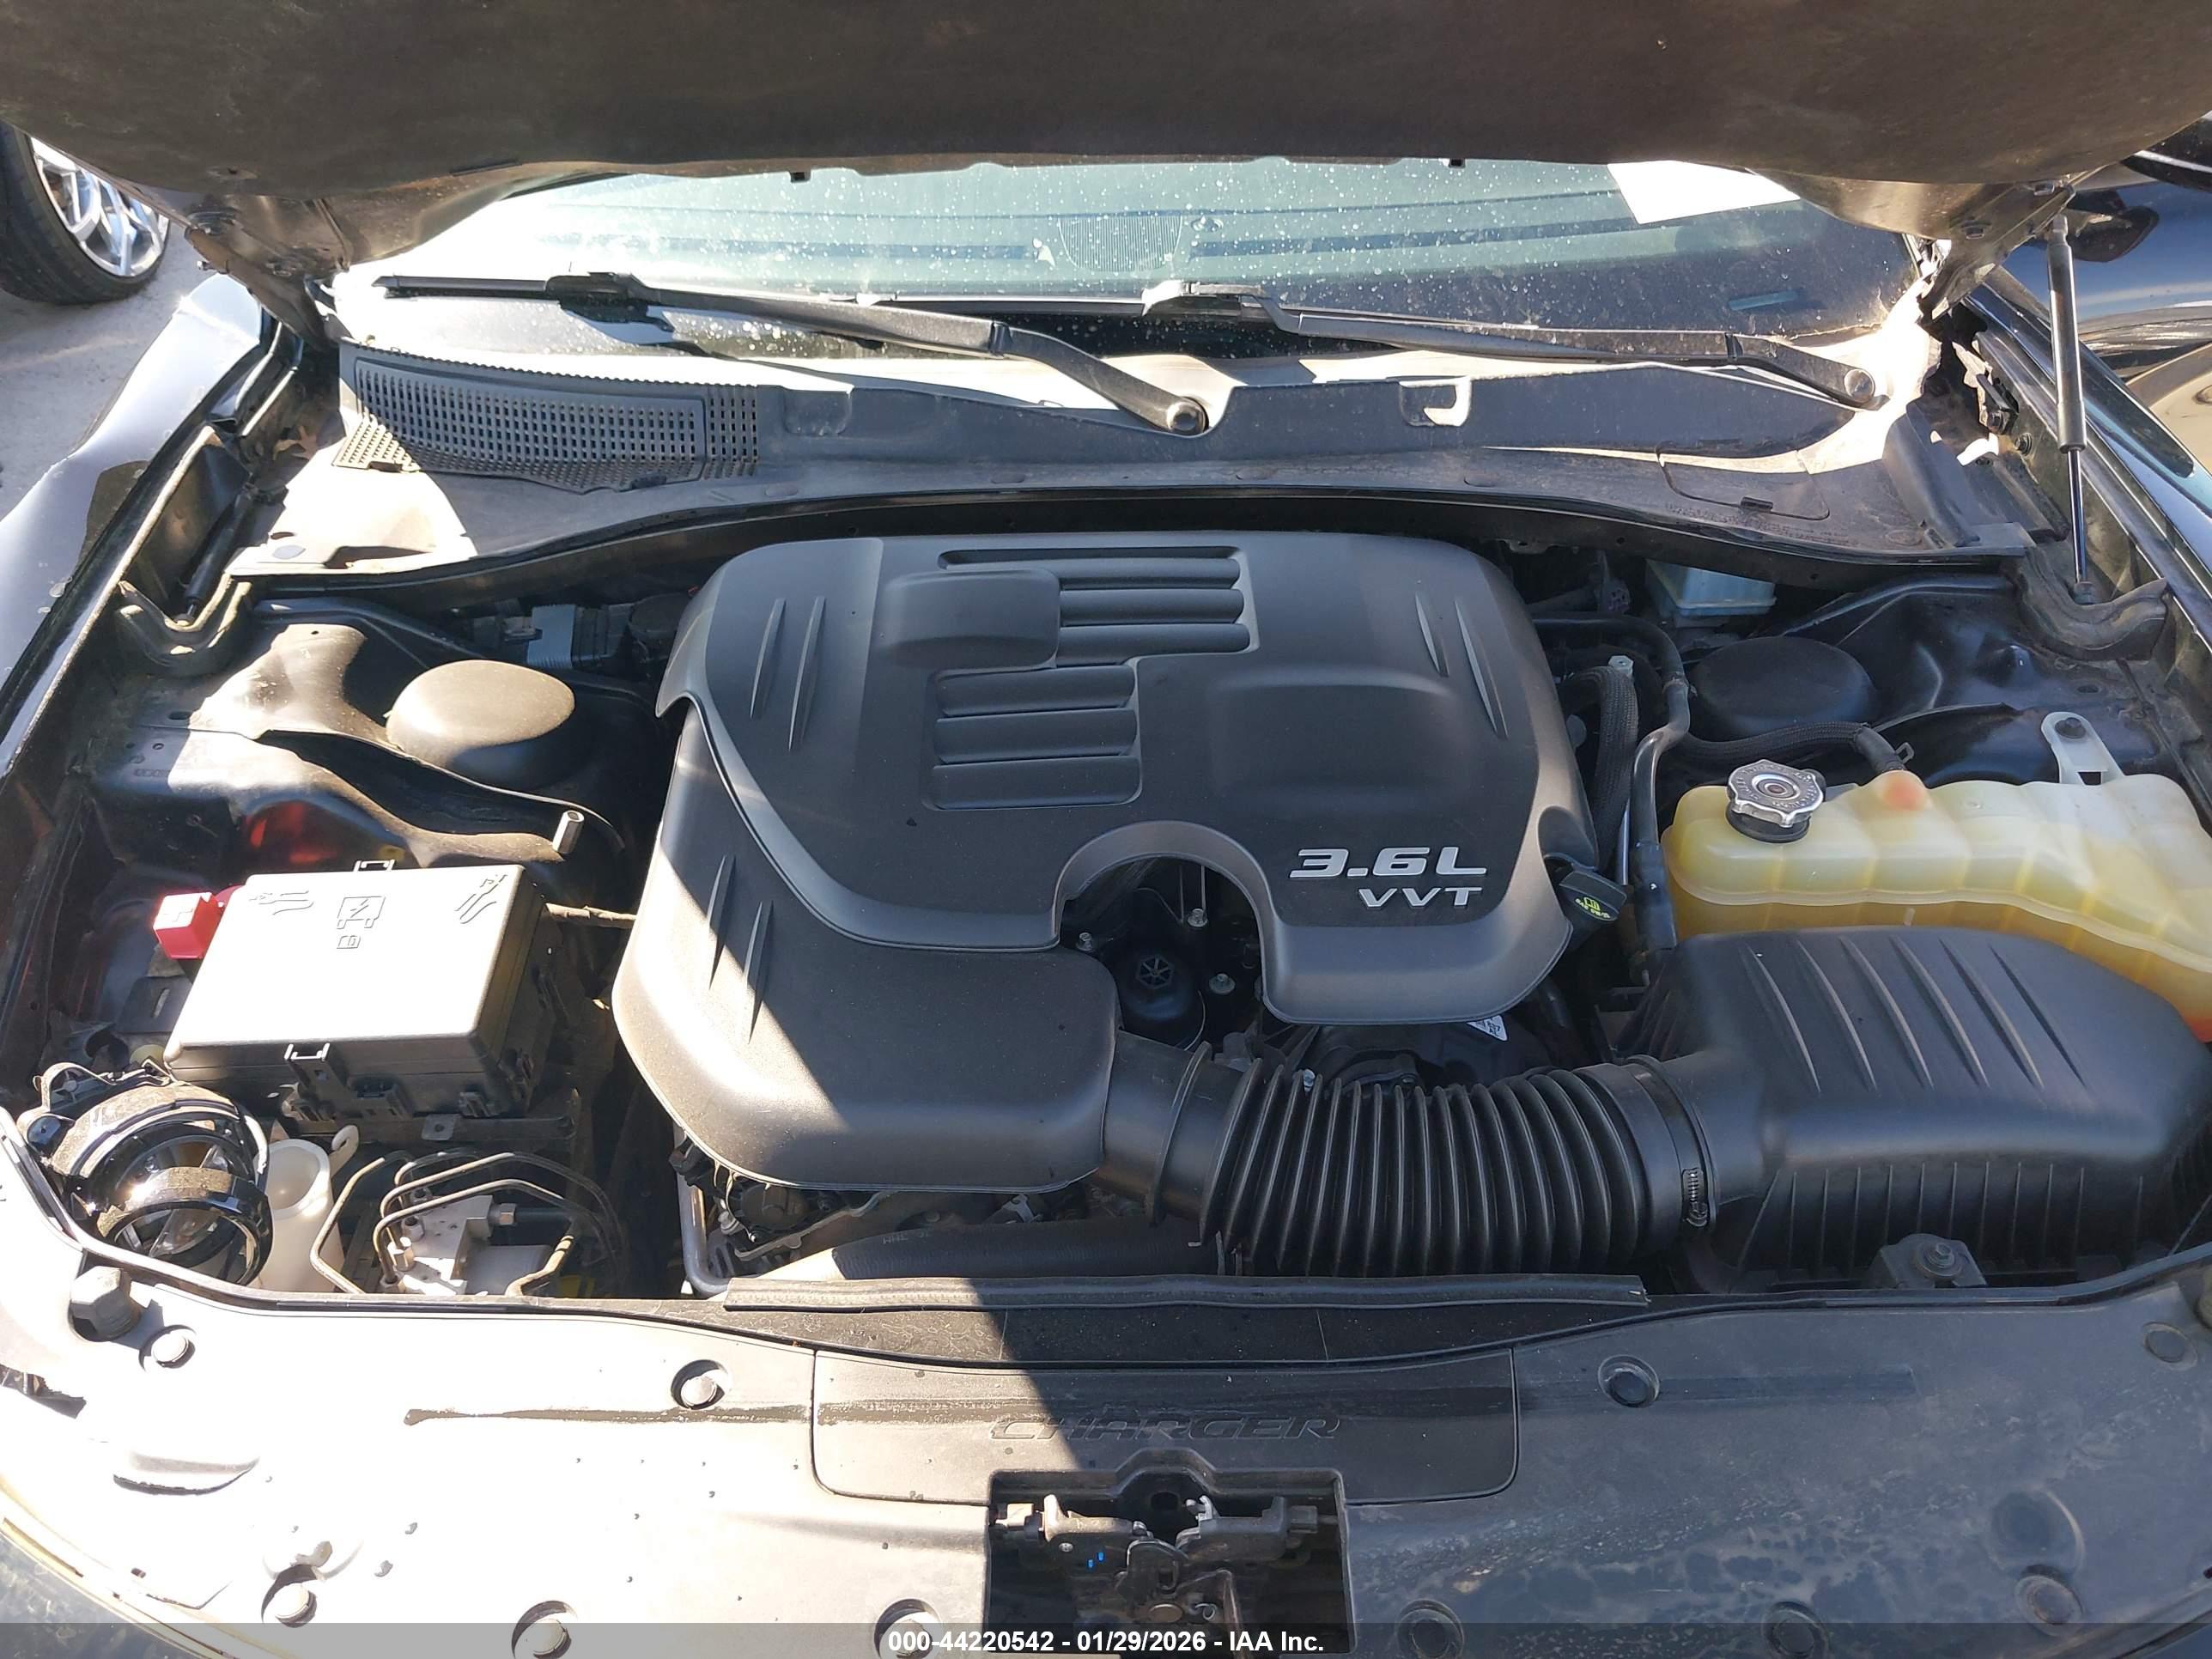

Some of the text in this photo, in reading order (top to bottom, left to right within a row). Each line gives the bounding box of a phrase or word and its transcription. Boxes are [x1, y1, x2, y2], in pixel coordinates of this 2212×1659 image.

[1289, 847, 1487, 878] 3.6L
[1358, 887, 1483, 908] VVT
[989, 1417, 1340, 1440] CHARGER
